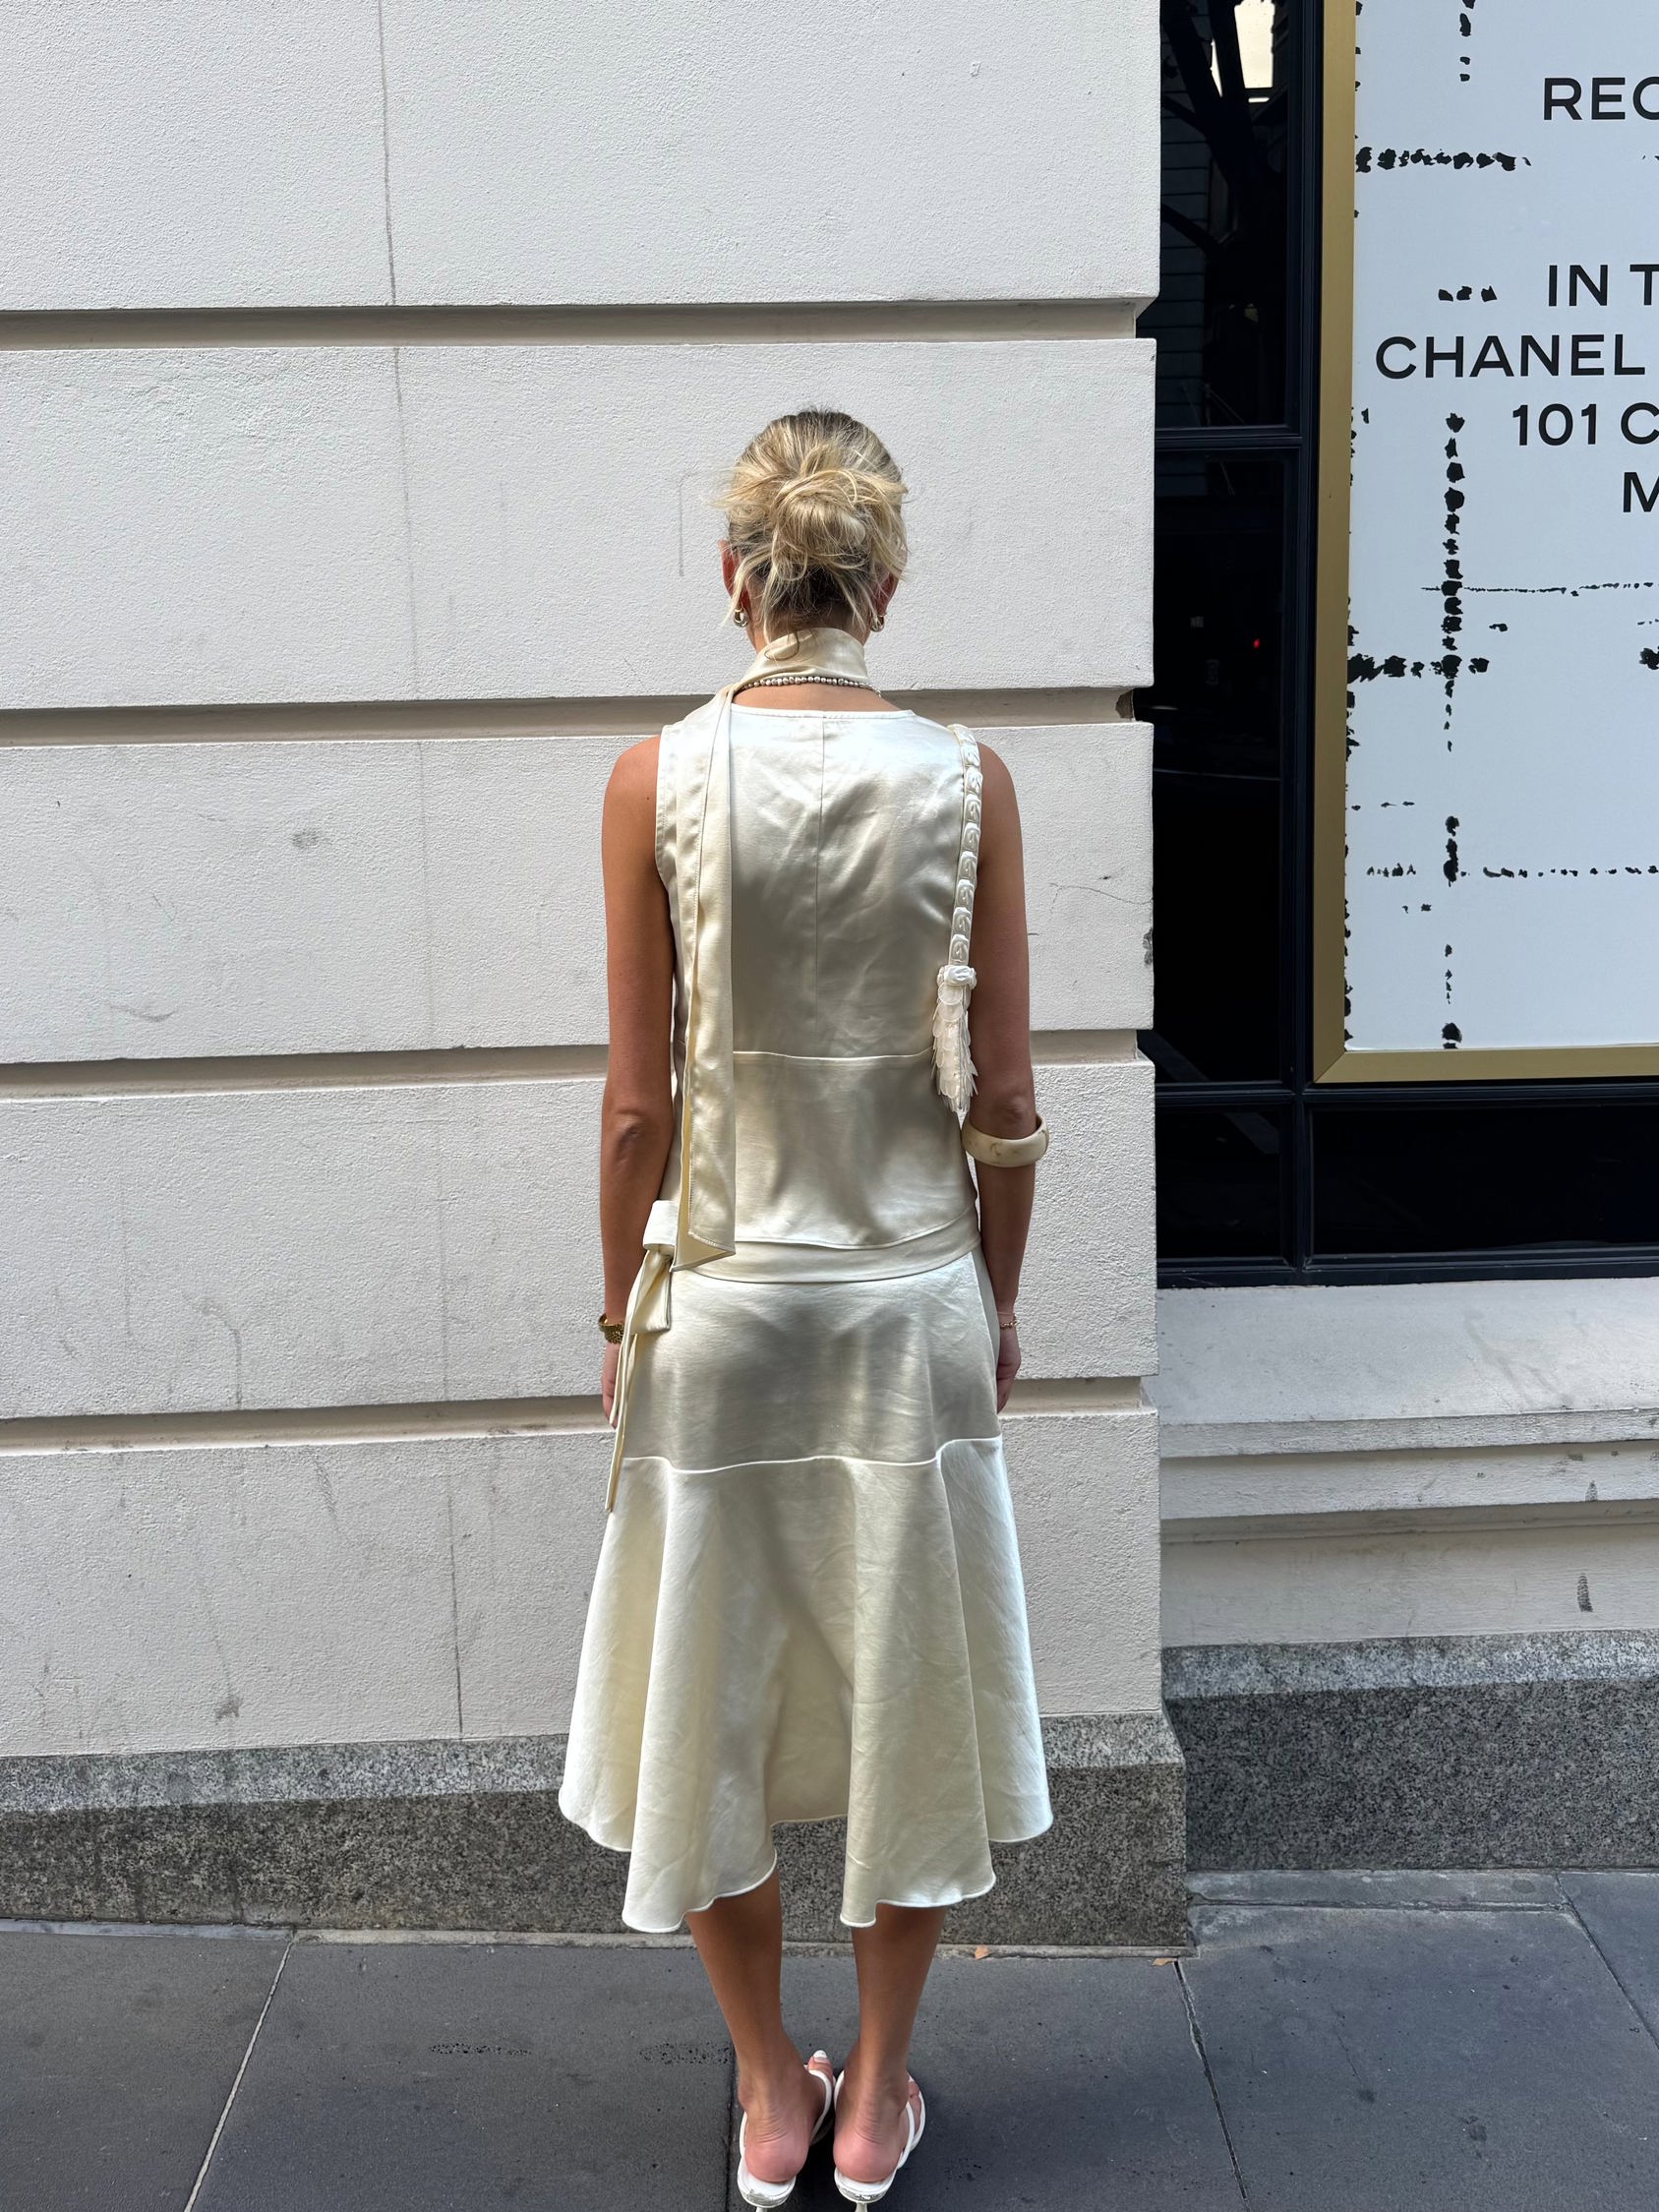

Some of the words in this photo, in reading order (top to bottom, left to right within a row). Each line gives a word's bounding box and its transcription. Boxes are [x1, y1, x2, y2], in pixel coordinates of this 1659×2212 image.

[1548, 264, 1609, 307] IN
[1629, 264, 1659, 306] T
[1375, 333, 1645, 380] CHANEL
[1511, 402, 1597, 447] 101
[1620, 401, 1659, 446] C
